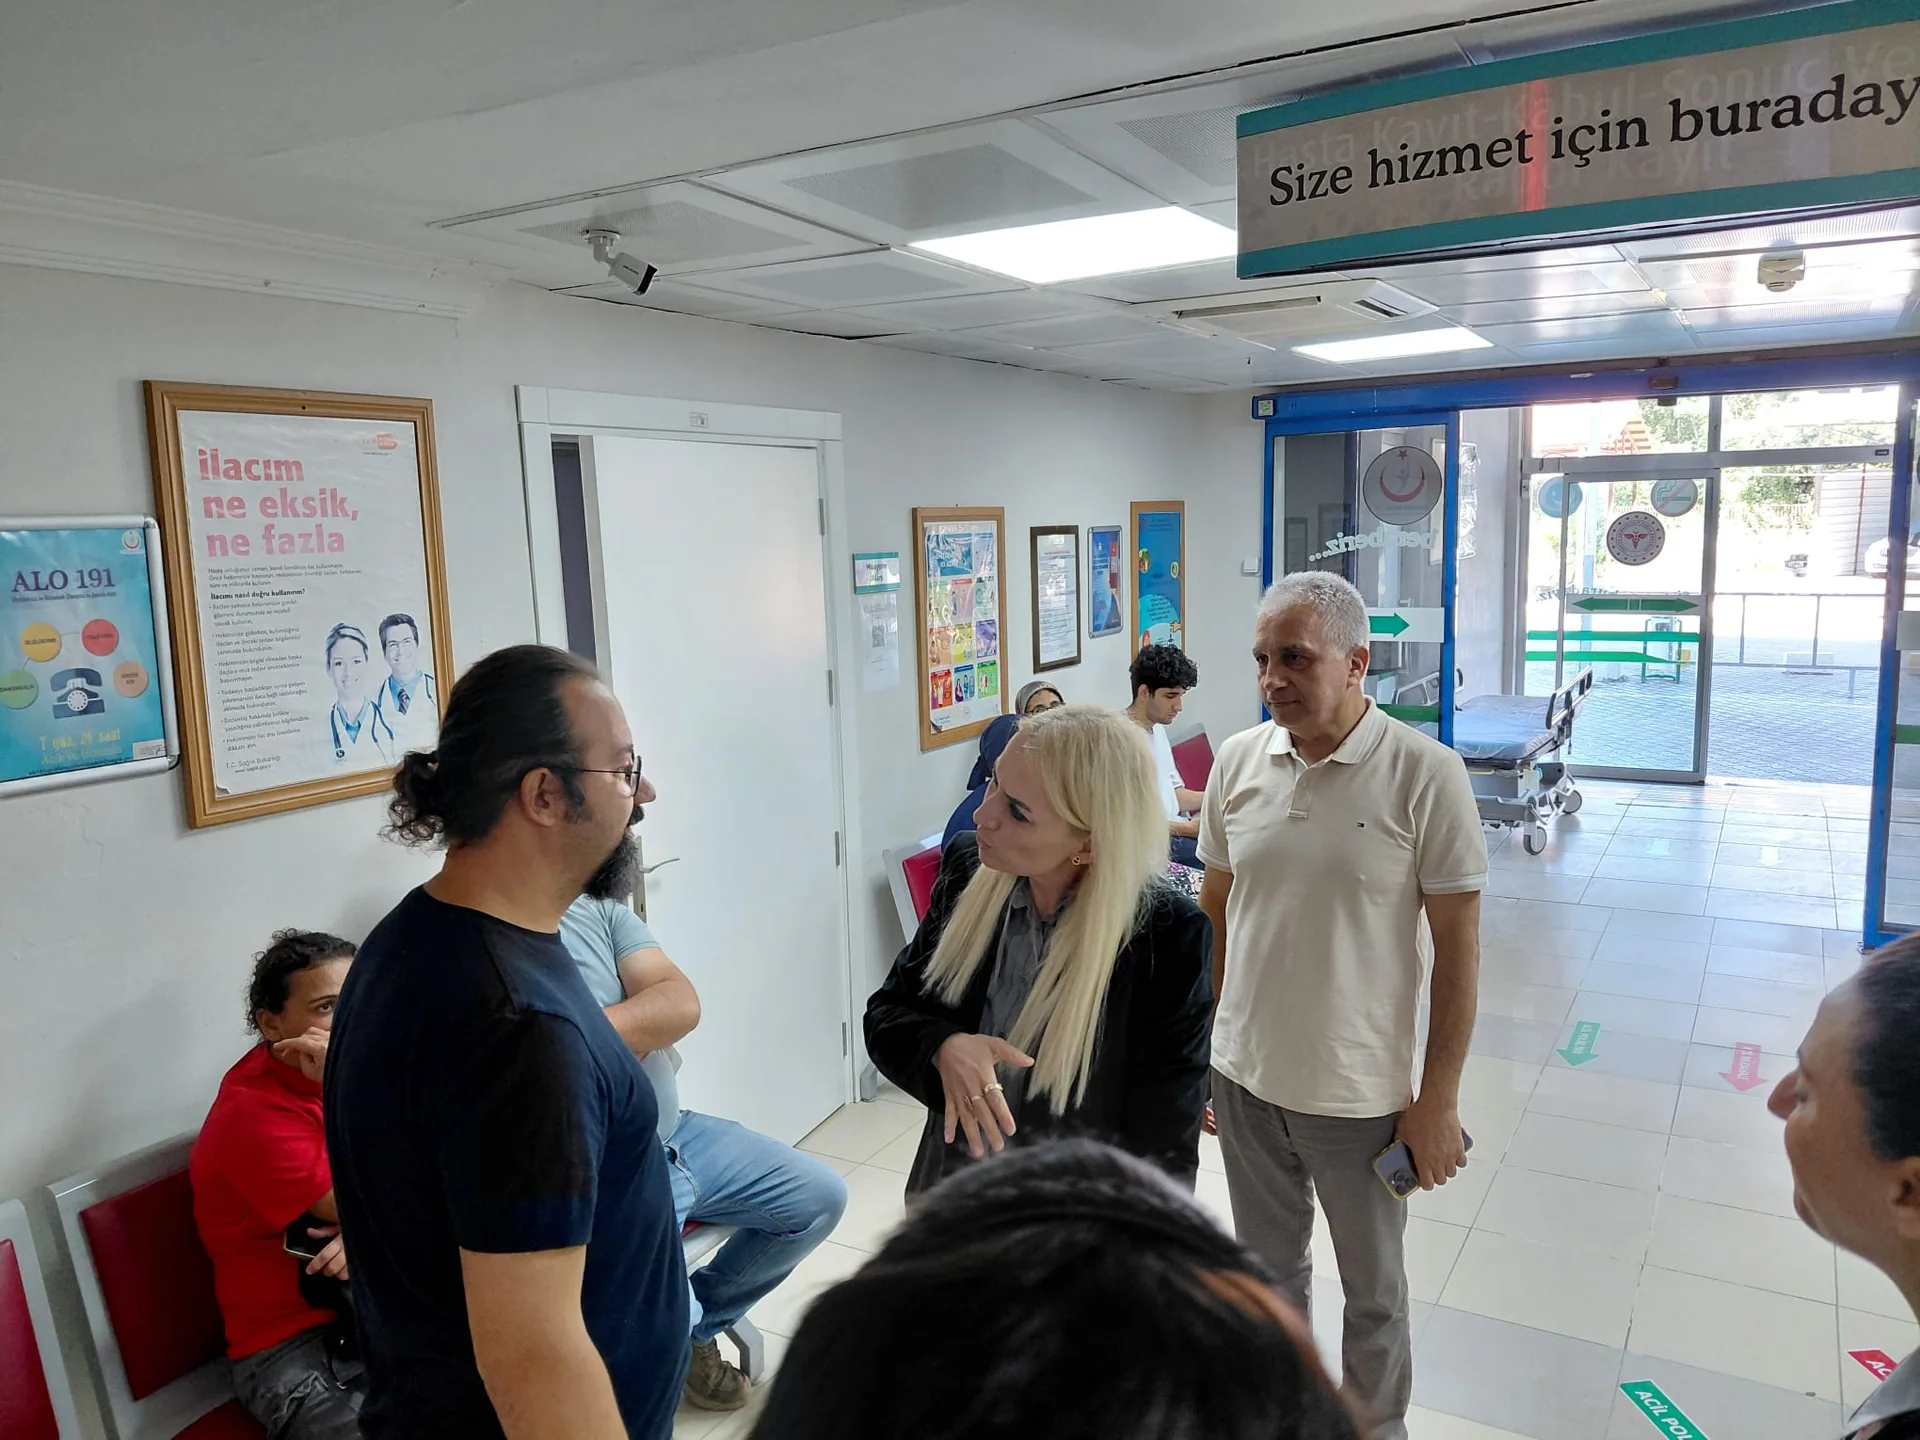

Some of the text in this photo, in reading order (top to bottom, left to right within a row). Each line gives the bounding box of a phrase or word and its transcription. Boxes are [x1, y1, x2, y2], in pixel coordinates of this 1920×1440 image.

[1270, 73, 1920, 205] Size hizmet için buraday
[198, 448, 304, 482] ilacım
[203, 487, 359, 521] ne eksik,
[206, 523, 345, 557] ne fazla
[11, 568, 116, 592] ALO 191
[234, 591, 250, 599] nasıl
[251, 590, 270, 598] doğru
[271, 588, 306, 597] kullanırım?
[1634, 1390, 1668, 1417] ACİL
